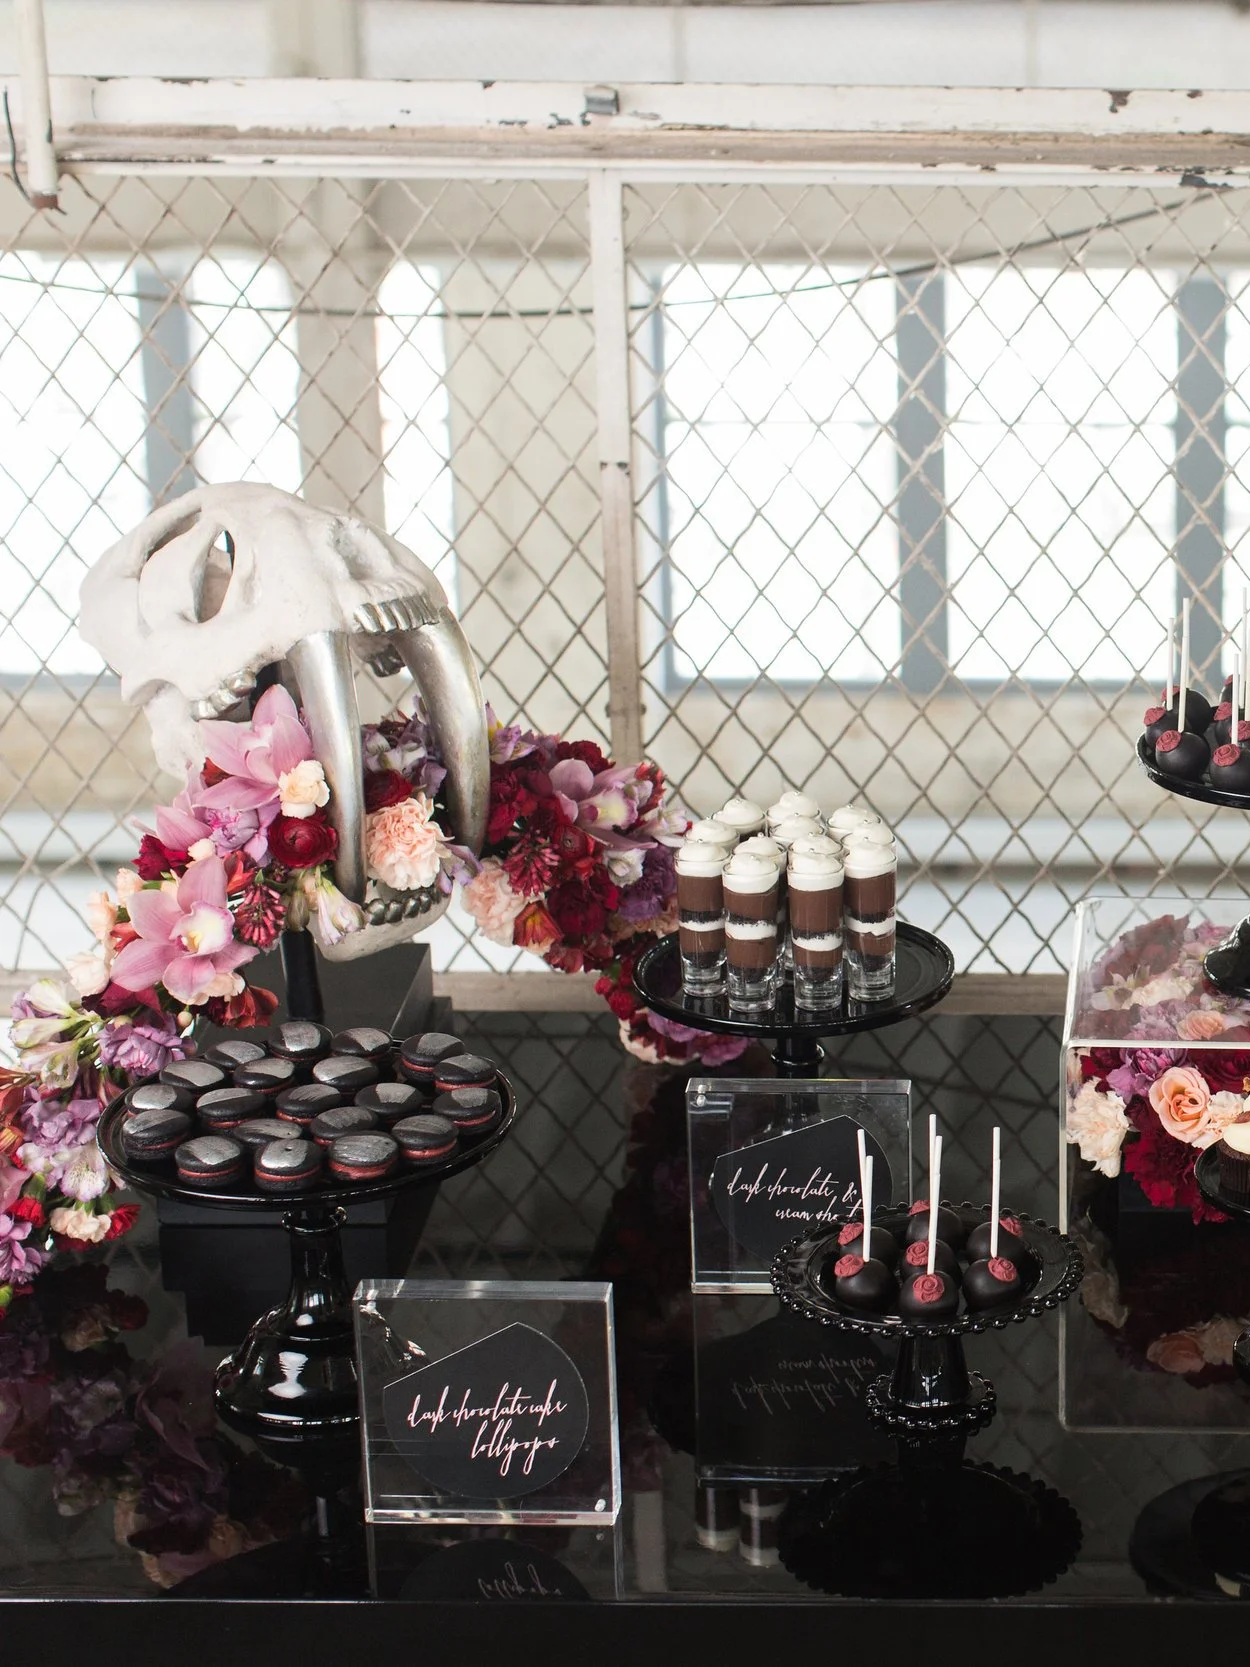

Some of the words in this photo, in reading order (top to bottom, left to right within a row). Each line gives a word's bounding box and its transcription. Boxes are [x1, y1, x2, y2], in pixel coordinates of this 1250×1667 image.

[727, 1162, 768, 1203] dark
[768, 1166, 840, 1200] chocolate
[842, 1182, 858, 1203] &
[775, 1208, 814, 1221] cream
[407, 1385, 451, 1433] dark
[453, 1382, 532, 1428] chocolate
[529, 1378, 568, 1427] cake
[470, 1418, 560, 1477] lollipops
